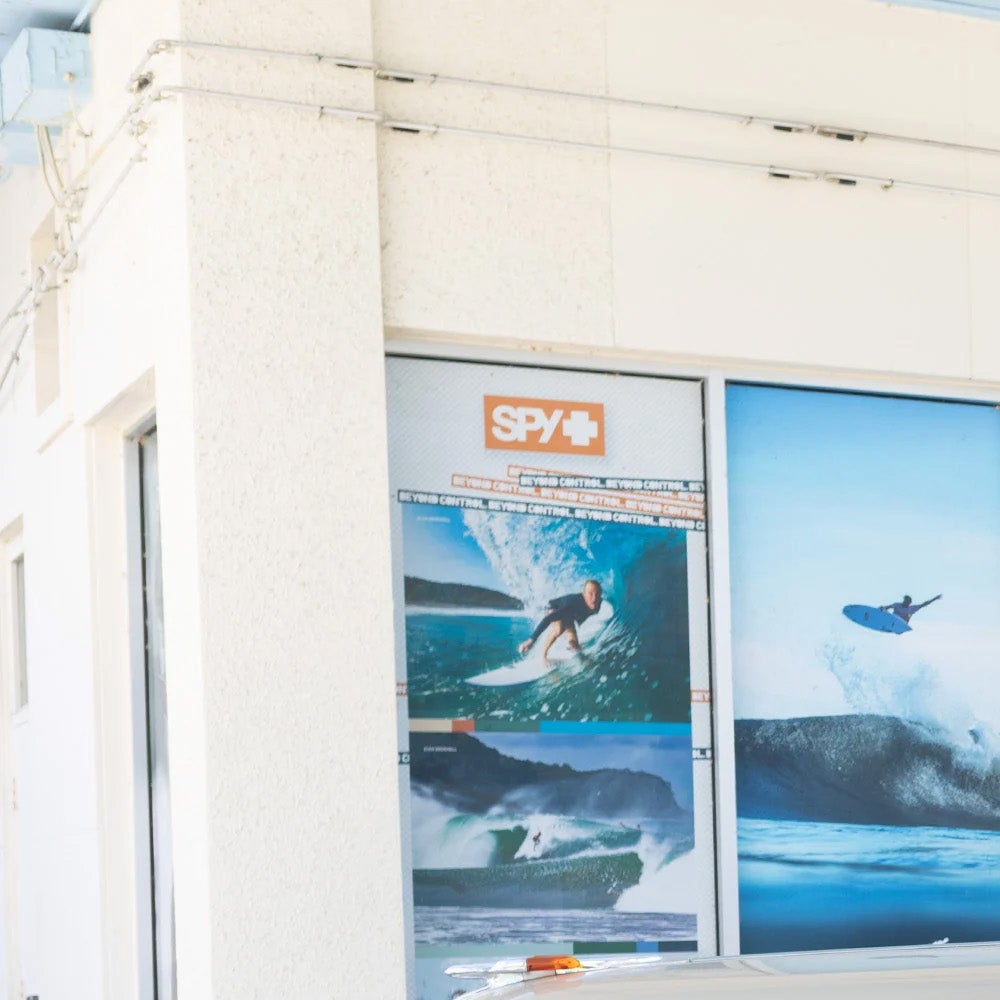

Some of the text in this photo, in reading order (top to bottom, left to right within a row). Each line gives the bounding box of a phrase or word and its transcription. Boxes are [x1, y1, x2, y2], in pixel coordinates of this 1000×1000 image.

[453, 476, 492, 489] BEYOND
[542, 487, 578, 502] BEYOND
[520, 476, 558, 488] BEYOND
[606, 479, 643, 490] BEYOND
[399, 491, 439, 504] BEYOND
[488, 500, 527, 513] BEYOND
[576, 508, 612, 521] BEYOND
[659, 518, 695, 529] BEYOND
